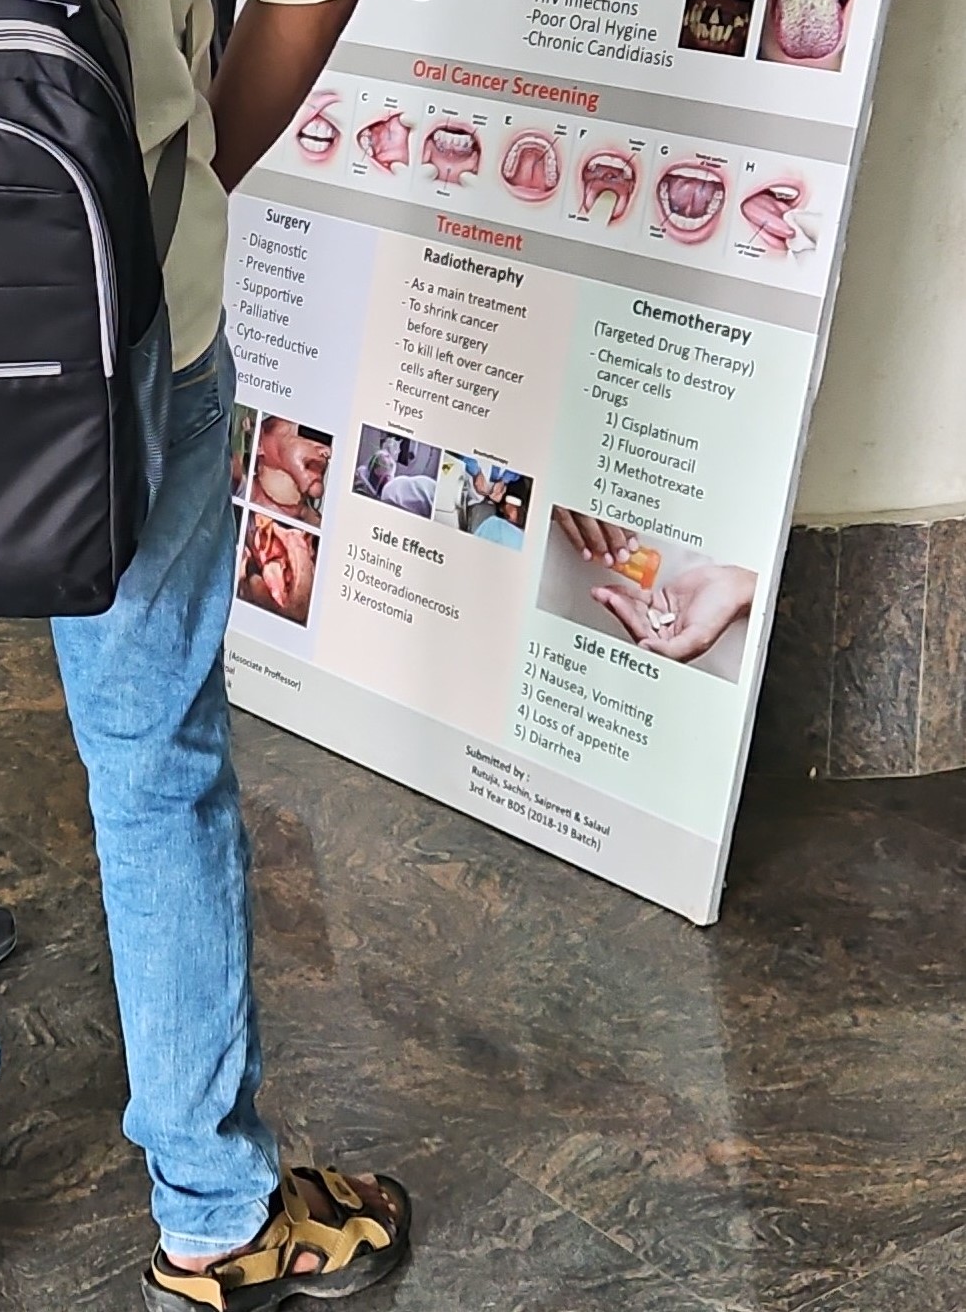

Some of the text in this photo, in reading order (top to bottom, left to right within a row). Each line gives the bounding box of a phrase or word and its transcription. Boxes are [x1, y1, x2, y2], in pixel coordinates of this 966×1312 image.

[569, 14, 600, 33] Oral
[604, 19, 656, 41] Hygine
[587, 39, 673, 67] Candidiasis
[413, 60, 599, 112] Oral Cancer Screening
[265, 208, 310, 233] Surgery
[436, 214, 522, 251] Treatment
[249, 232, 307, 260] Diagnostic
[245, 255, 304, 283] Preventive
[423, 247, 524, 287] Radiotheraphy
[242, 277, 303, 306] Supportive
[411, 277, 526, 318] As a main treatment
[239, 299, 289, 326] Palliative
[409, 297, 499, 332] To shrink cancer
[632, 299, 751, 345] Chemotherapy
[236, 322, 318, 358] Cyto-reductive
[406, 318, 488, 354] before surgery
[594, 320, 754, 377] (Targeted Drug Therapy)
[403, 338, 524, 384] To kill left over cancer
[597, 348, 735, 399] Chemicals to destroy
[395, 379, 490, 417] Recurrent cancer
[400, 362, 499, 401] cells after surgery
[591, 384, 628, 406] Drugs
[596, 369, 671, 398] cancer cells
[393, 398, 423, 419] Types
[605, 411, 698, 450] 1) Cisplatinum
[601, 433, 695, 473] 2) Fluorouracil
[593, 477, 660, 509] 4) Taxanes
[597, 455, 703, 499] 3) Methotrexate
[589, 498, 702, 546] 5) Carboplatinum
[347, 543, 402, 577] 1) Staining
[371, 526, 444, 564] Side Effects
[340, 585, 412, 623] 3) Xerostomia
[343, 564, 459, 619] 2) Osteoradionecrosis
[528, 641, 587, 675] 1) Fatigue
[573, 634, 659, 679] Side Effects
[524, 661, 536, 678] 2)
[539, 667, 587, 699] Nausea,
[517, 704, 629, 761] 4) Loss of appetite
[521, 682, 648, 745] 3) General weakness
[465, 744, 524, 779] Submitted by
[514, 723, 580, 762] 5) Diarrhea
[486, 788, 505, 805] Year
[507, 798, 525, 815] BDS
[570, 827, 600, 852] Batch)
